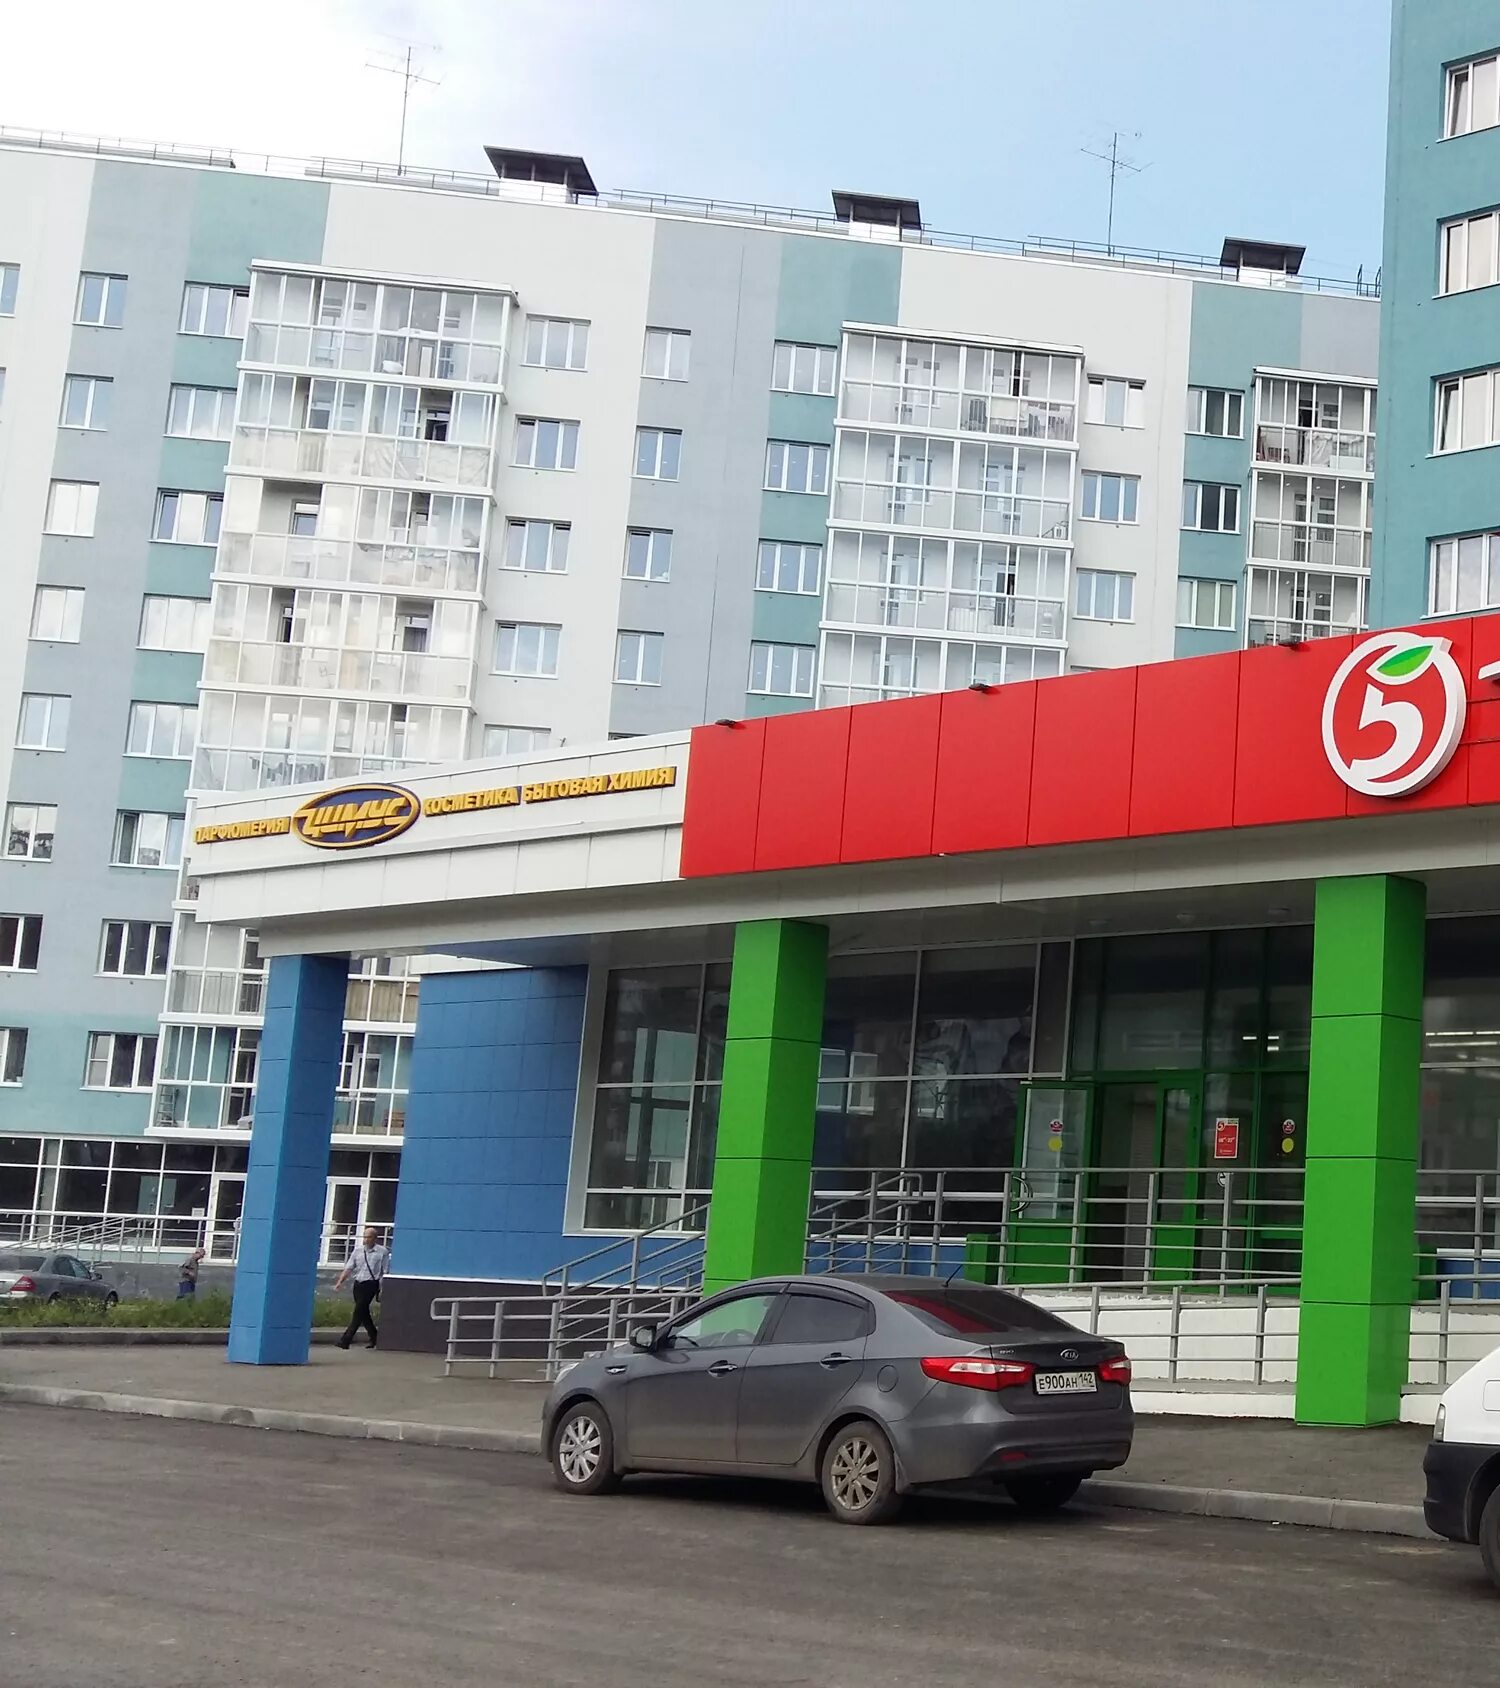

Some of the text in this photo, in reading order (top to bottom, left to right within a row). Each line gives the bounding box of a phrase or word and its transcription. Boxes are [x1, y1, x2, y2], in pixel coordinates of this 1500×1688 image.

[423, 766, 677, 817] КОСМЕТИКА БЫТОВАЯ ХИМИЯ
[194, 816, 291, 844] ПАРФЮМЕРИЯ
[1079, 1372, 1093, 1384] 142
